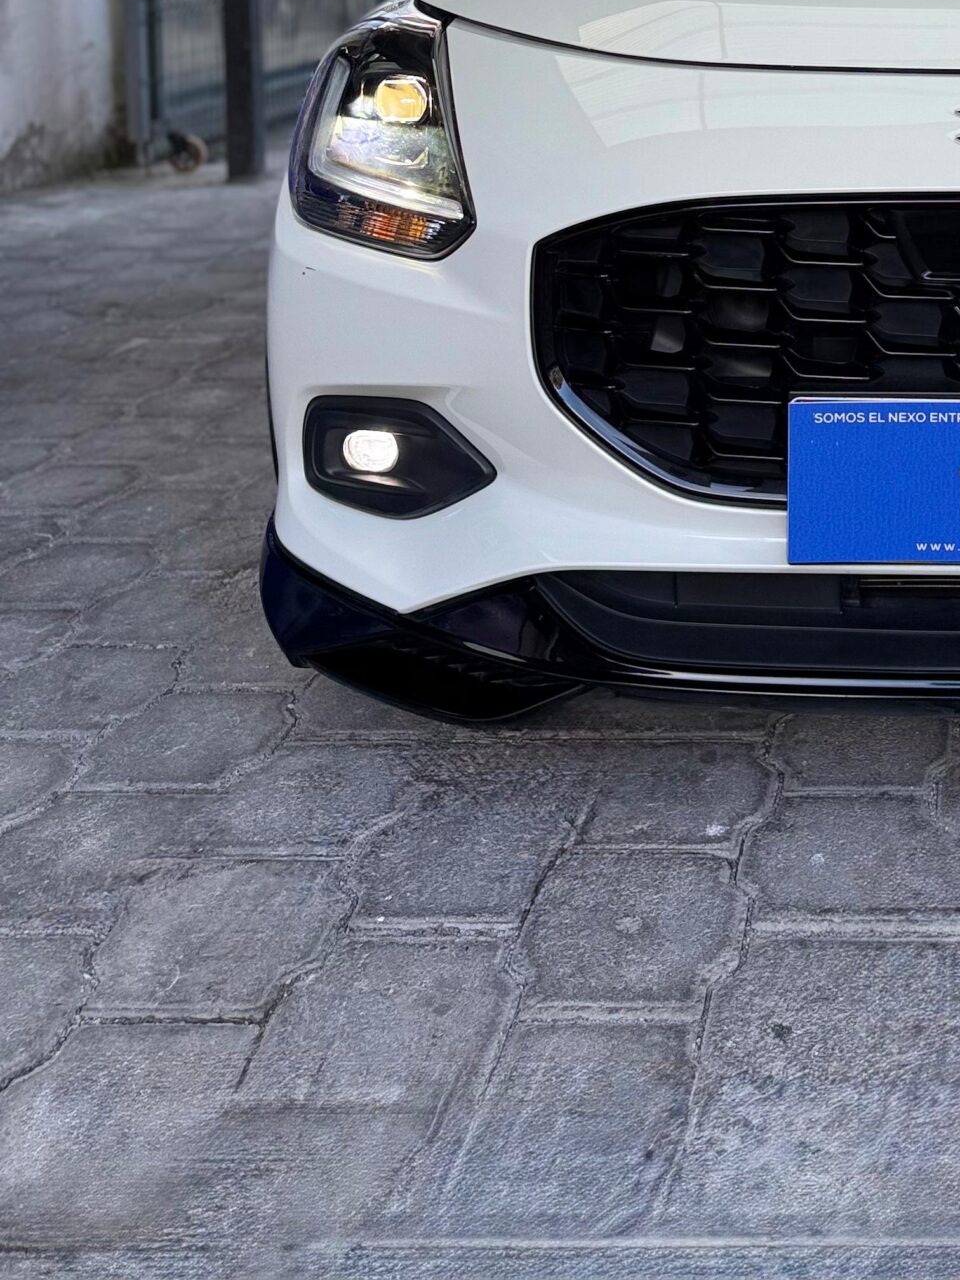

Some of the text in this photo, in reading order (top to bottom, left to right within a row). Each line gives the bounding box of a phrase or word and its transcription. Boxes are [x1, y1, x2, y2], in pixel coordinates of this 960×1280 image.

[814, 412, 865, 424] SOMOS
[868, 412, 885, 423] EL
[888, 412, 926, 423] NEXO
